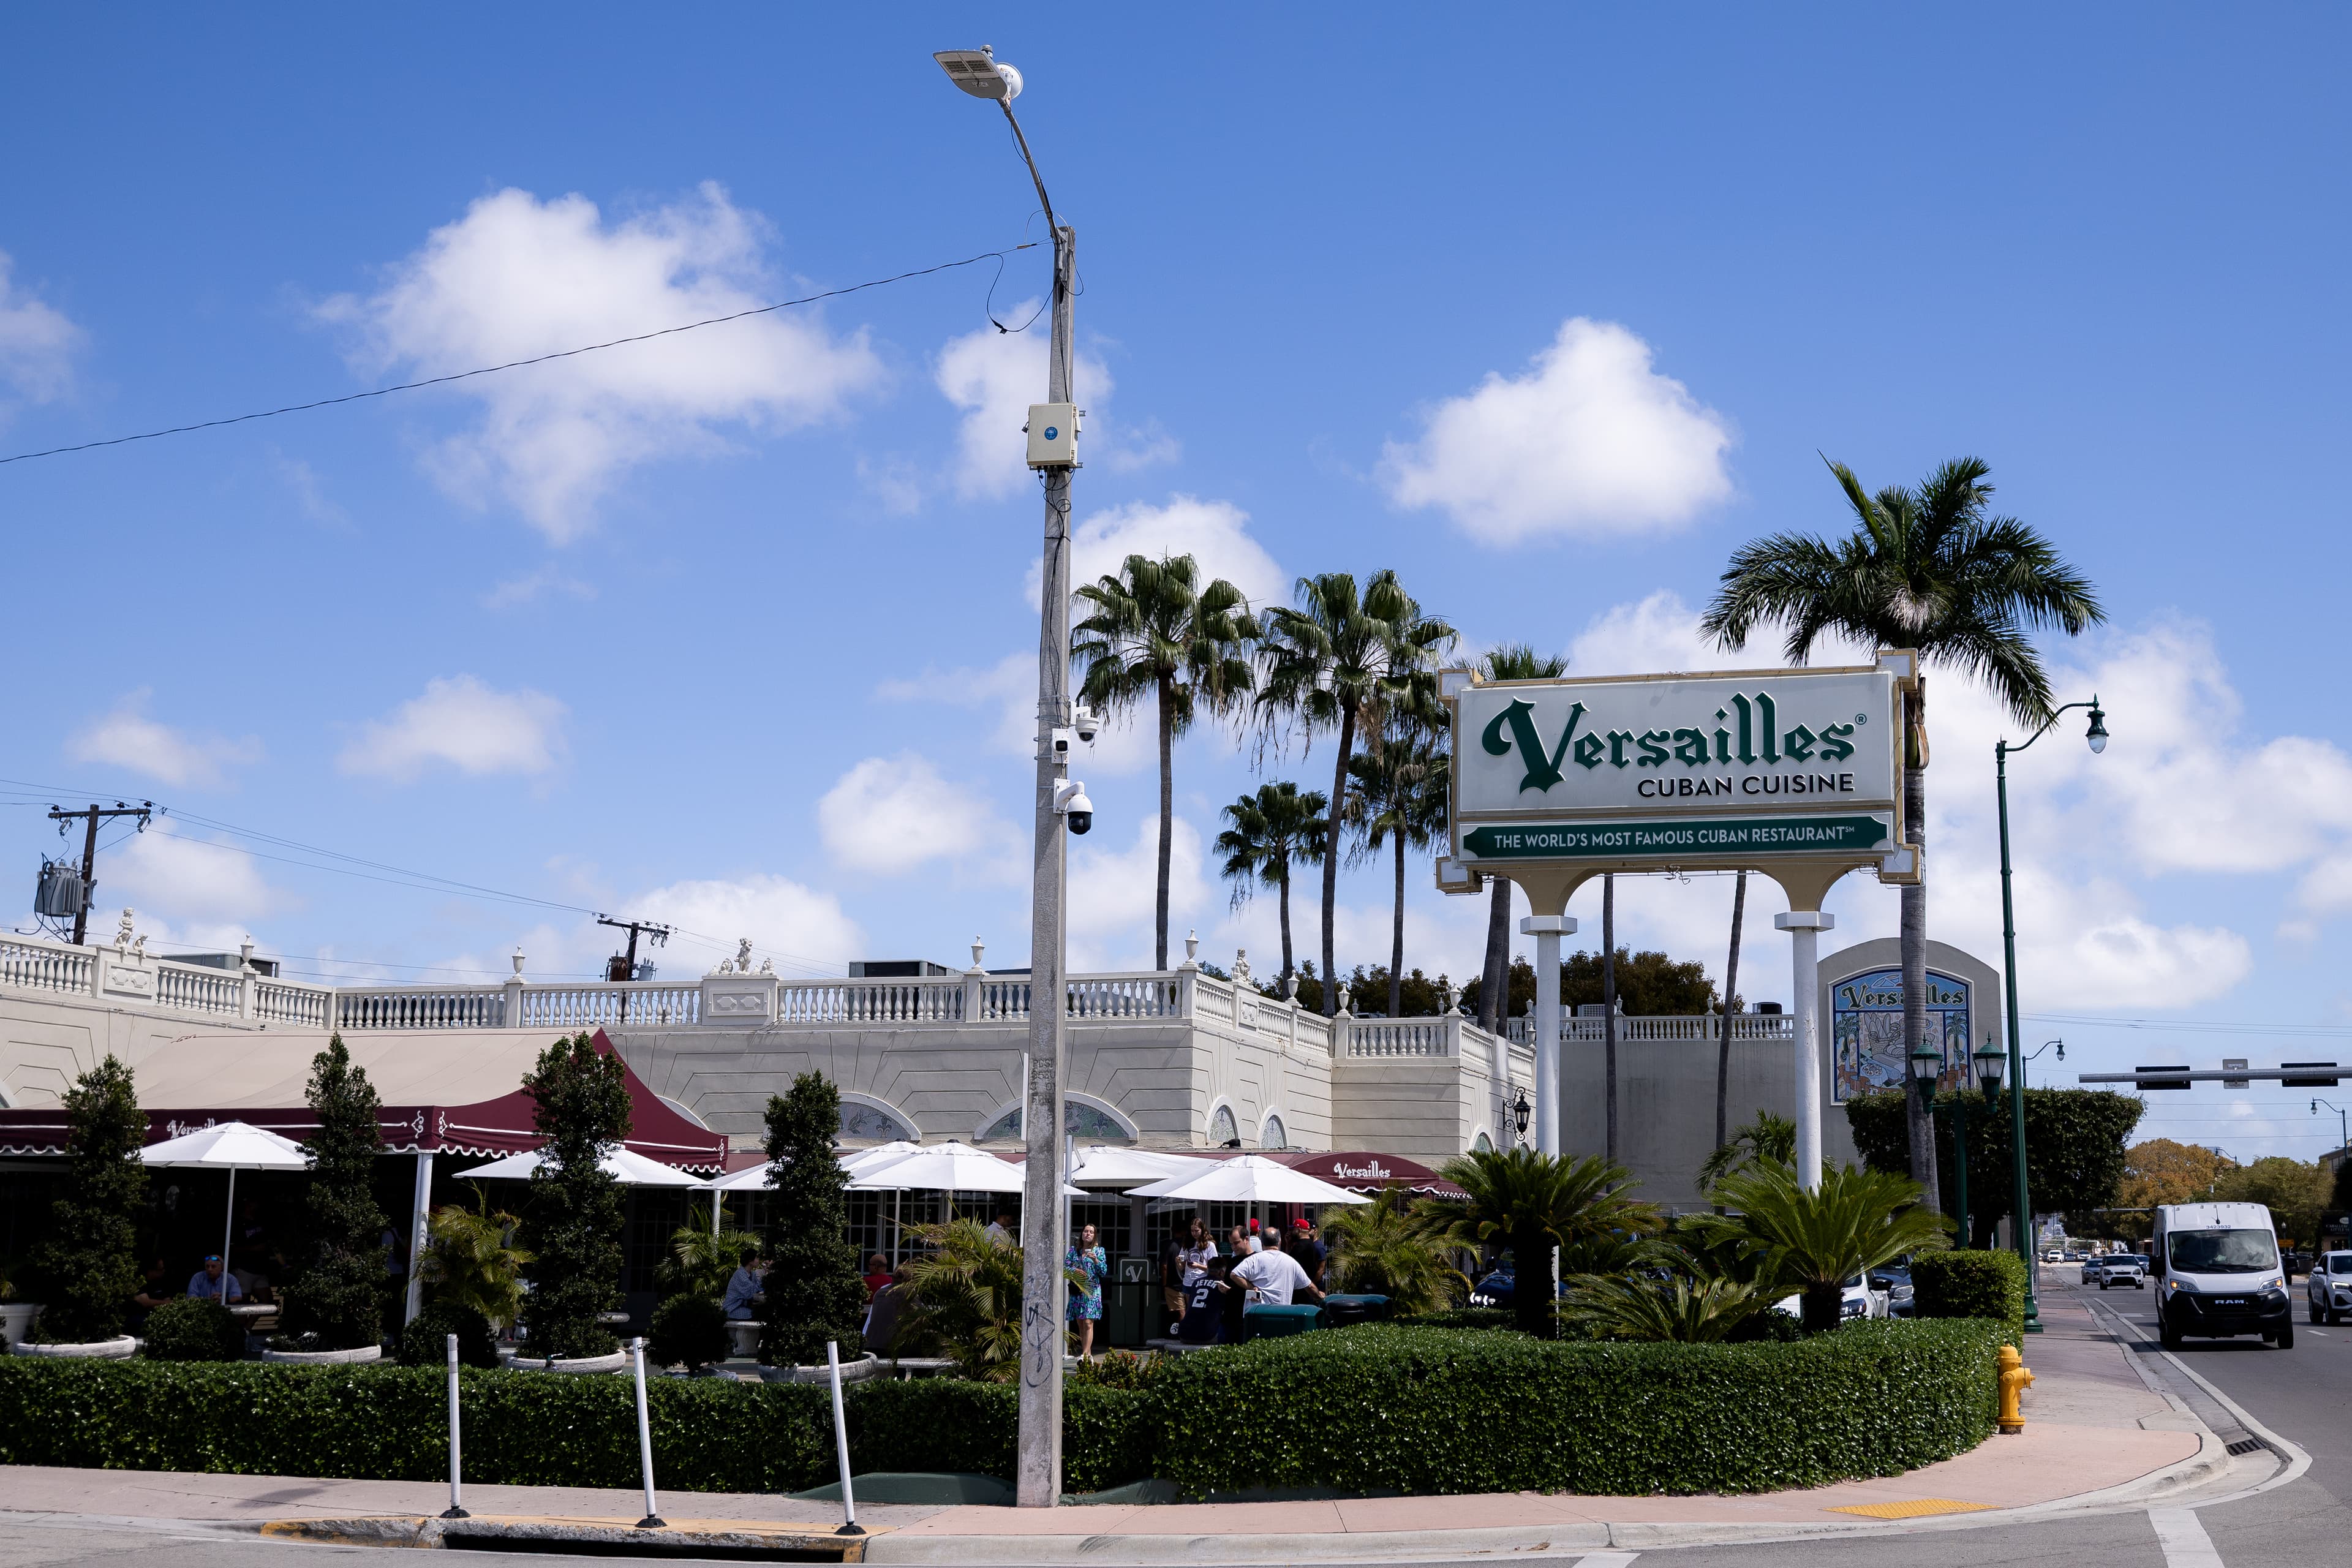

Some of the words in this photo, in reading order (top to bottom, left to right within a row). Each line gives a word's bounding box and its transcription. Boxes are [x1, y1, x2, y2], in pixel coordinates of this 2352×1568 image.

[1637, 776, 1733, 797] CUBAN
[1741, 772, 1855, 795] CUISINE
[1494, 834, 1521, 848] THE
[1525, 832, 1588, 848] WORLD'S
[1593, 831, 1631, 846] MOST
[1635, 829, 1694, 845] FAMOUS
[1698, 827, 1747, 843] CUBAN
[1333, 1160, 1390, 1179] Versailles
[1126, 1265, 1143, 1283] V
[1191, 1288, 1209, 1308] 2
